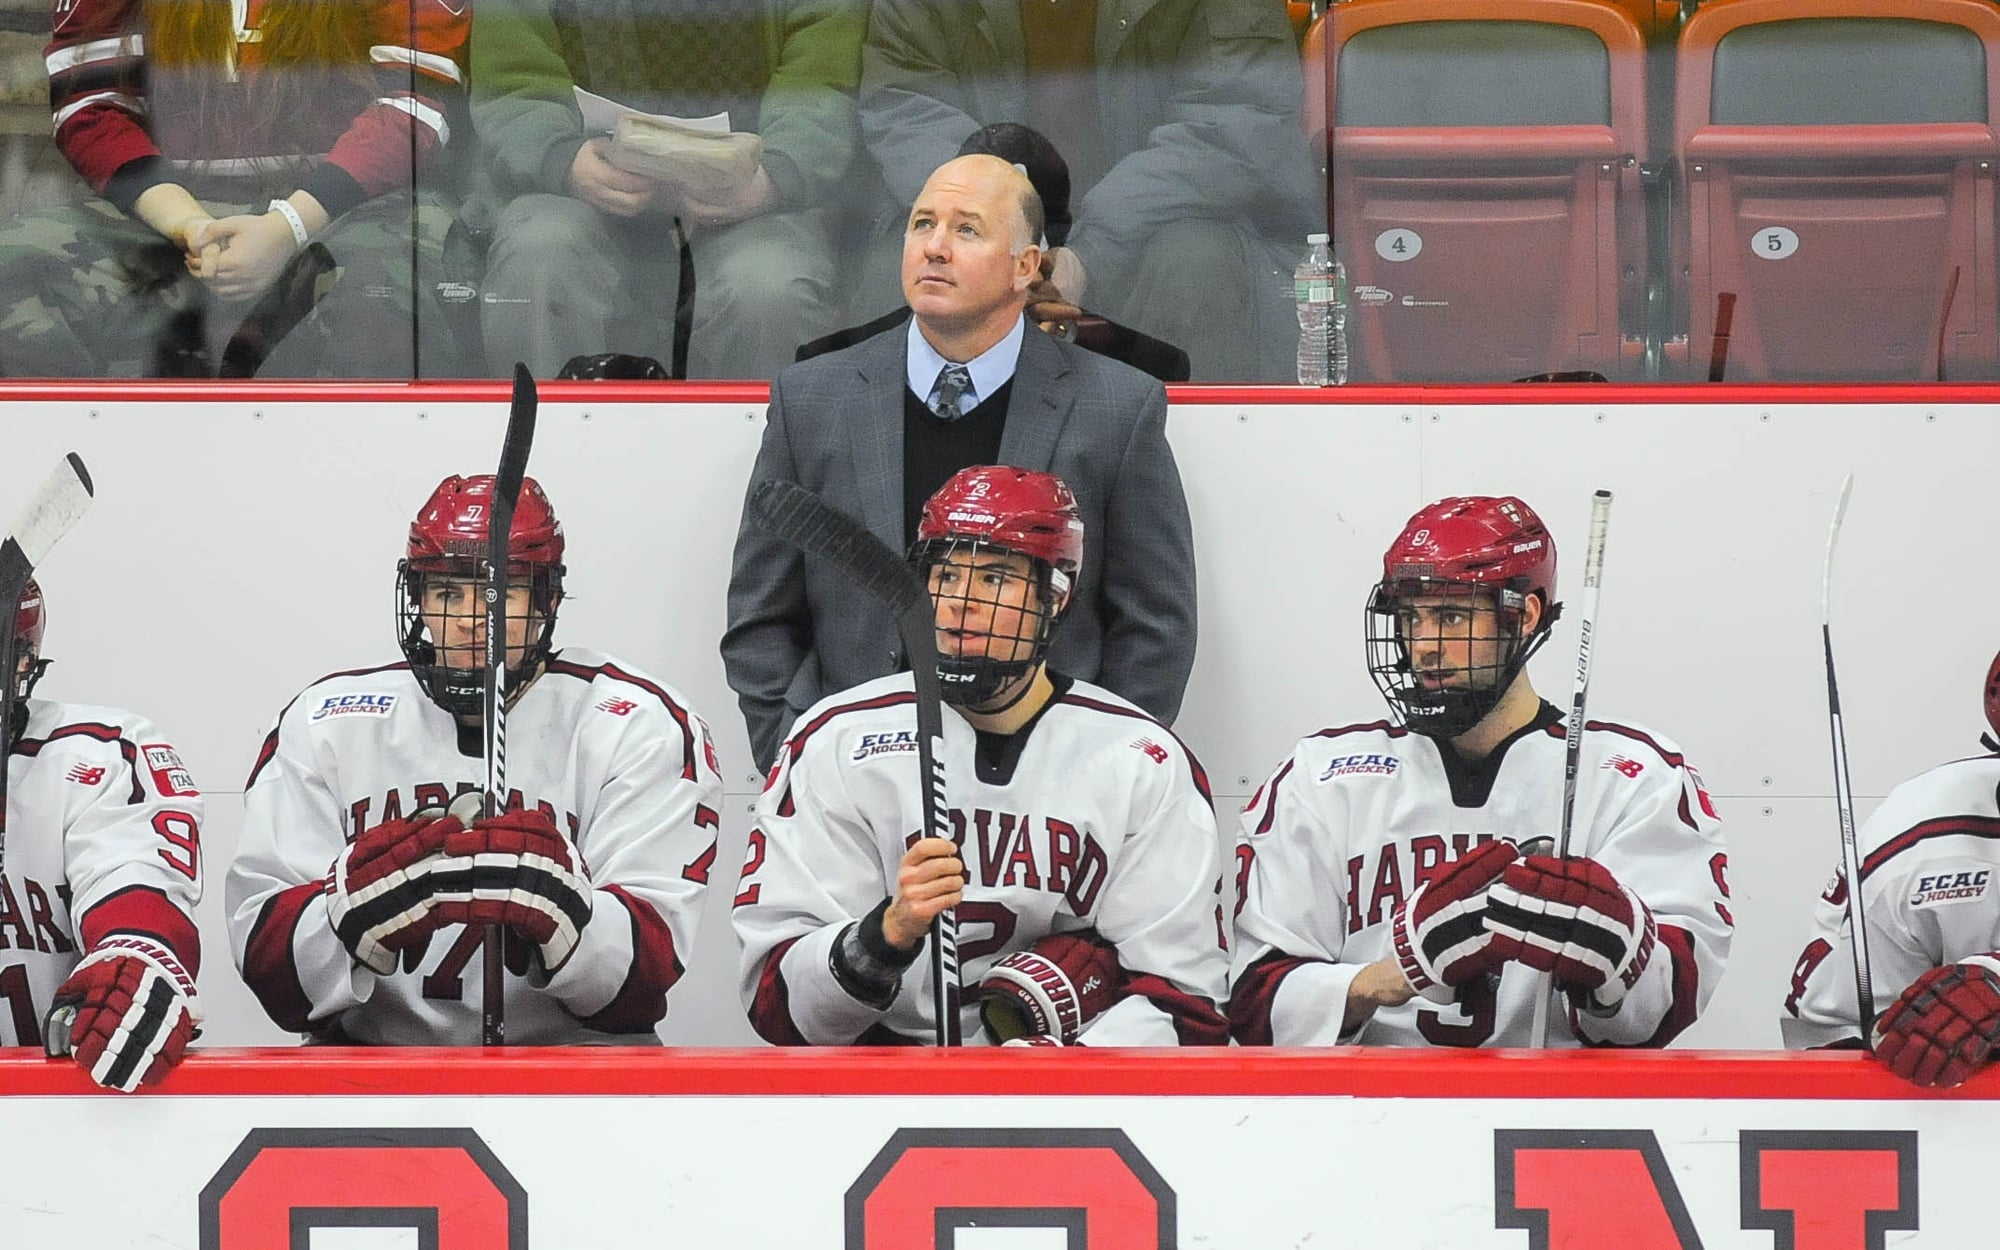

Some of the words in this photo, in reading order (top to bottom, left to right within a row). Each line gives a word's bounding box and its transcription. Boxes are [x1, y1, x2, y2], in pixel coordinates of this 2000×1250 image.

[1391, 236, 1407, 253] 4
[1767, 234, 1782, 251] 5
[971, 481, 991, 497] 2
[466, 505, 483, 521] 7
[1411, 529, 1430, 547] 9
[321, 694, 396, 710] ECAC
[329, 705, 390, 716] HOCKEY
[1568, 706, 1583, 750] ESPOSITO
[859, 731, 919, 749] ECA
[869, 743, 917, 756] HOCKE
[1328, 754, 1400, 770] ECAC
[1335, 765, 1396, 776] HOCKEY
[151, 810, 200, 881] 9
[1918, 870, 1990, 893] ECAC
[1926, 885, 1986, 902] HOCKEY
